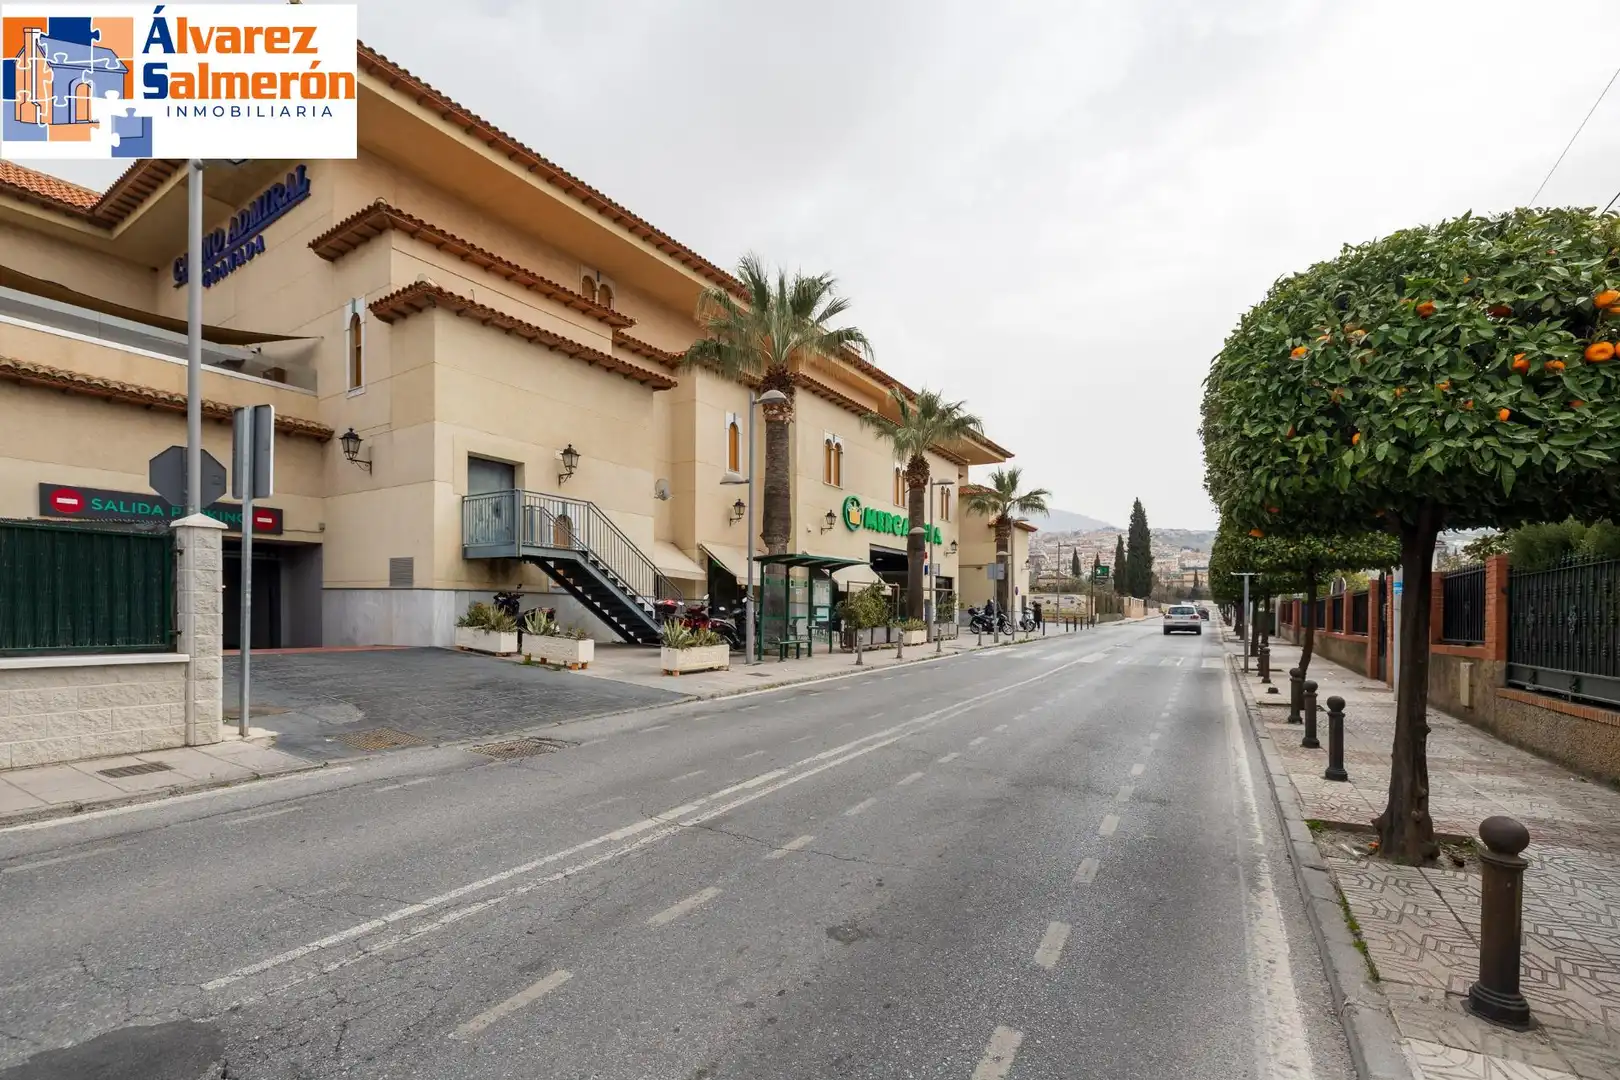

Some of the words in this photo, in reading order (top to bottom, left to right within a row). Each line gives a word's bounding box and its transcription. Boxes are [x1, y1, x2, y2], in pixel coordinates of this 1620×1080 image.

[173, 227, 226, 282] CNO
[227, 164, 311, 244] ADMIRAL
[91, 497, 164, 517] SALIDA
[171, 505, 243, 522] PKING
[863, 506, 943, 545] MERCANA
